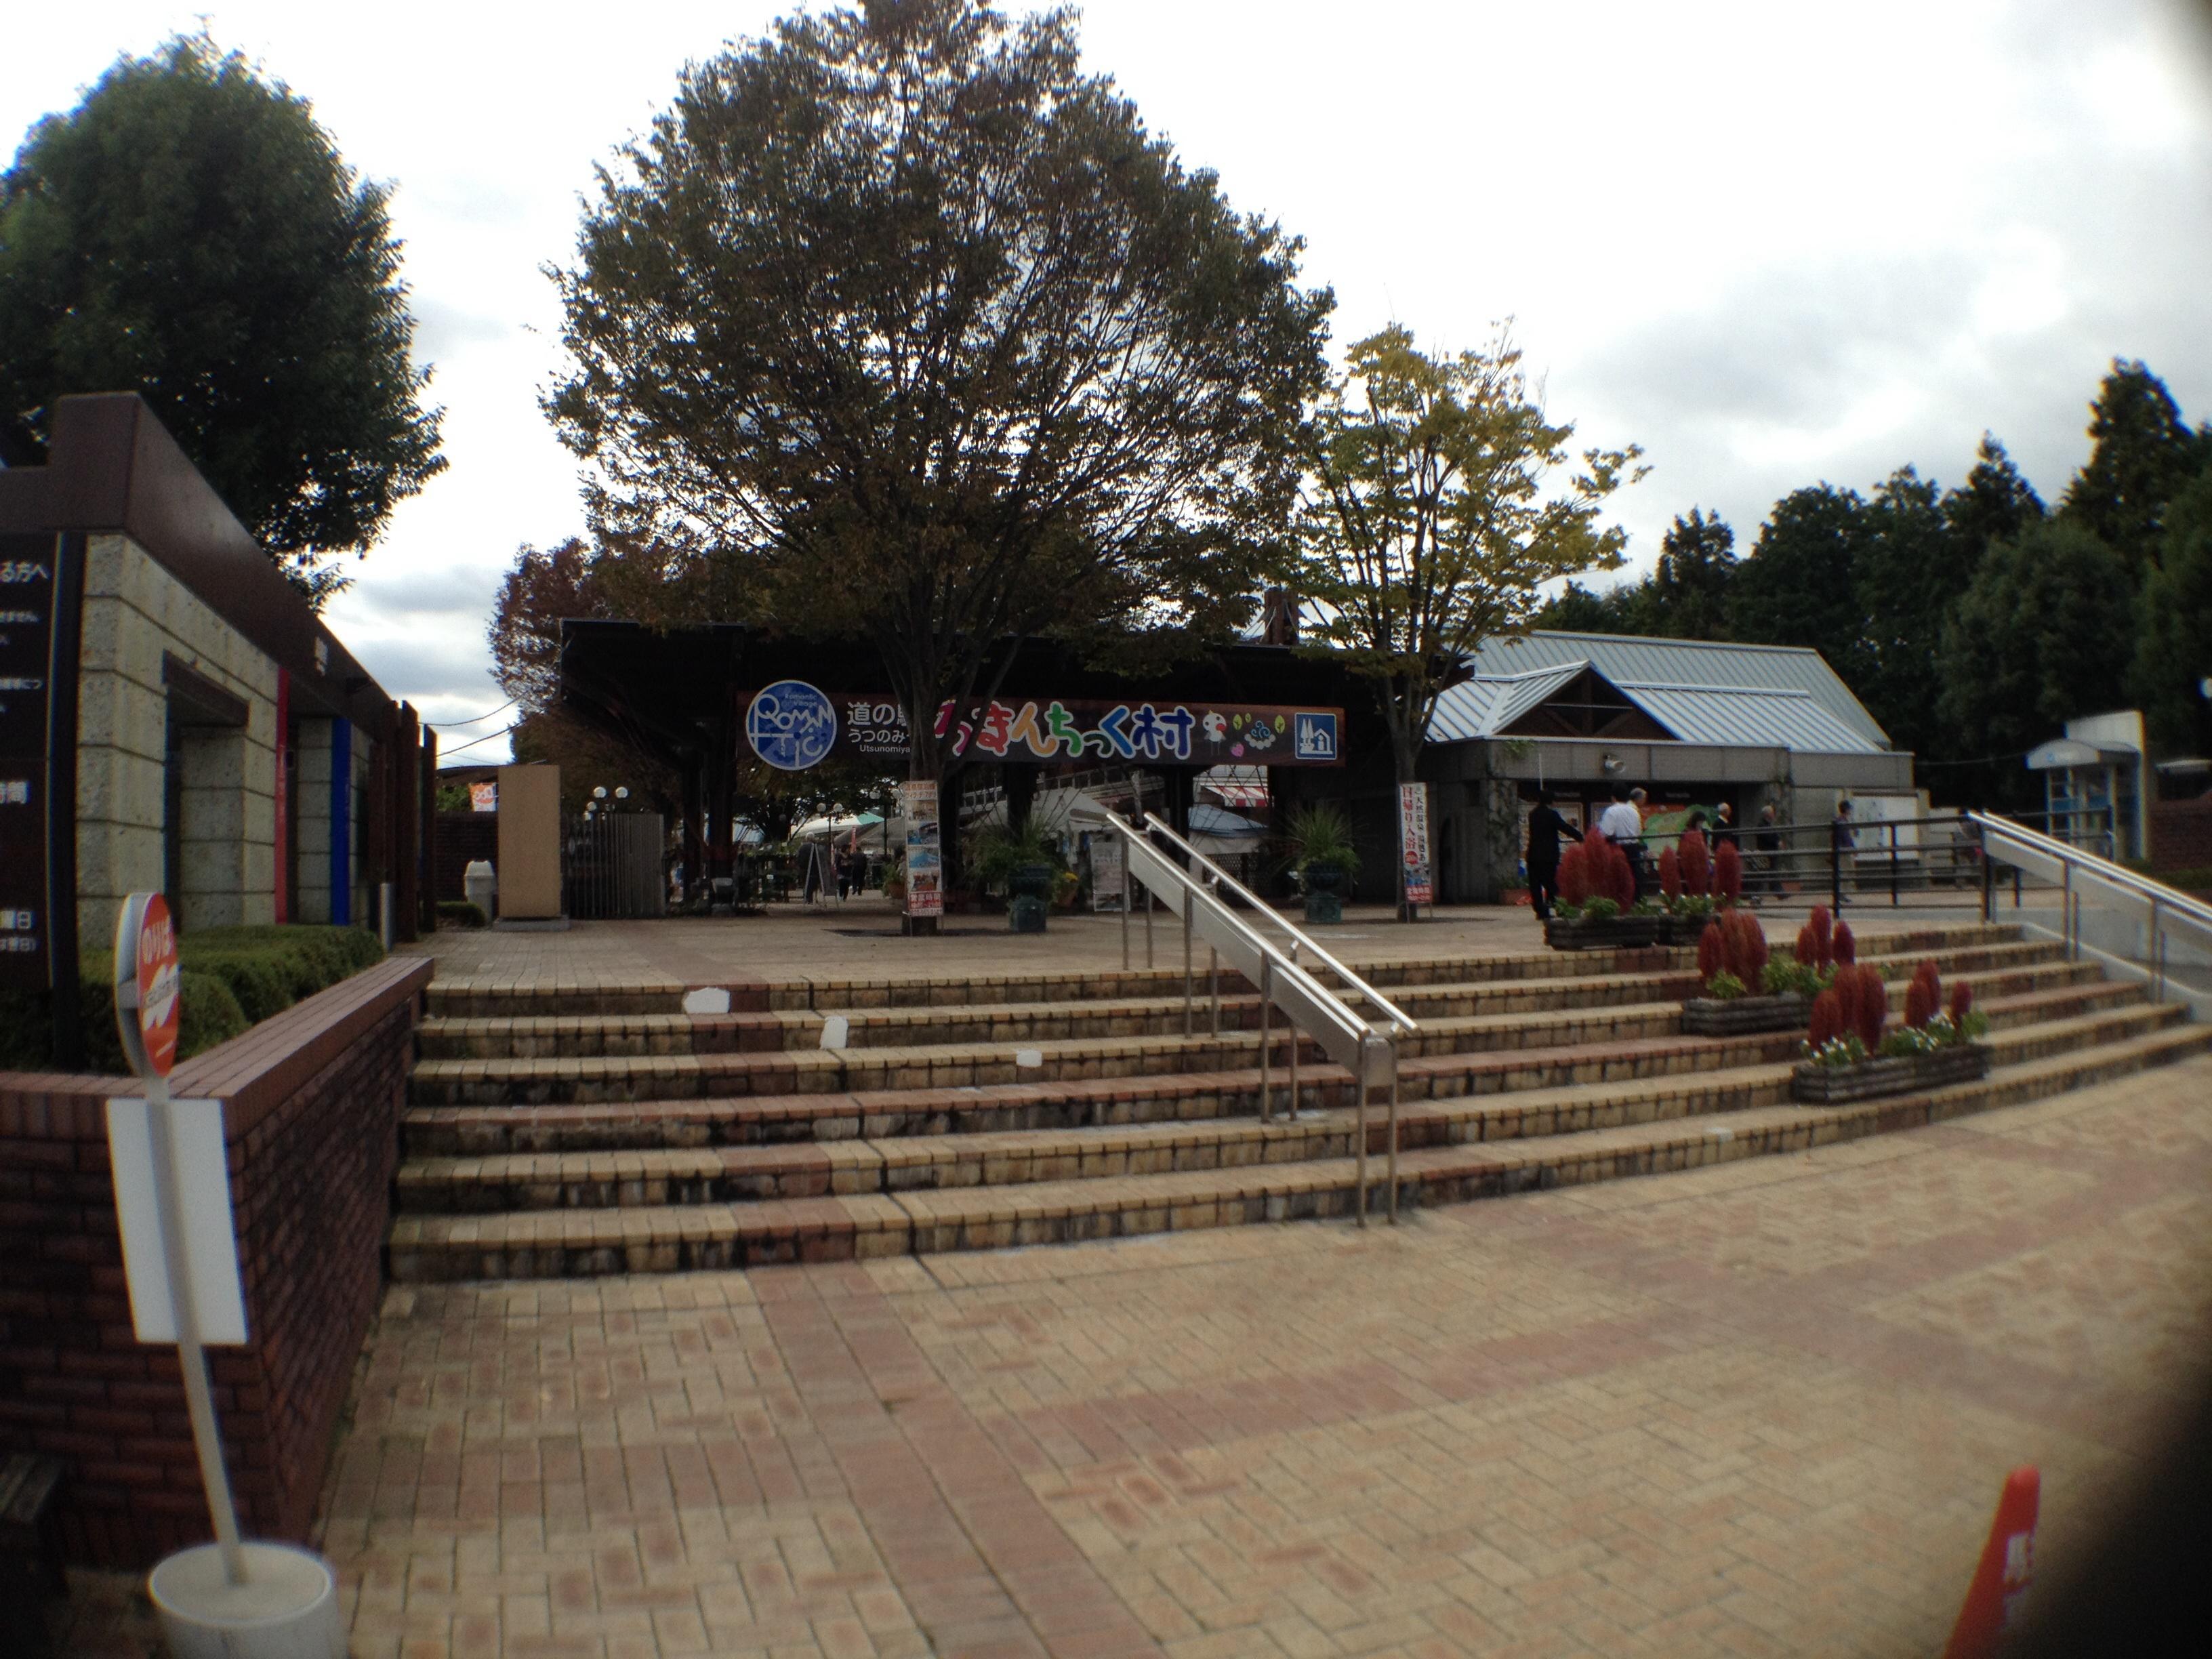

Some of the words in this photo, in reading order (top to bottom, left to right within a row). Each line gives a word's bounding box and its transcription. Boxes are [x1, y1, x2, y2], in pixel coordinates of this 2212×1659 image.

[848, 728, 911, 743] うつのみ
[859, 744, 912, 754] Utsunomiya
